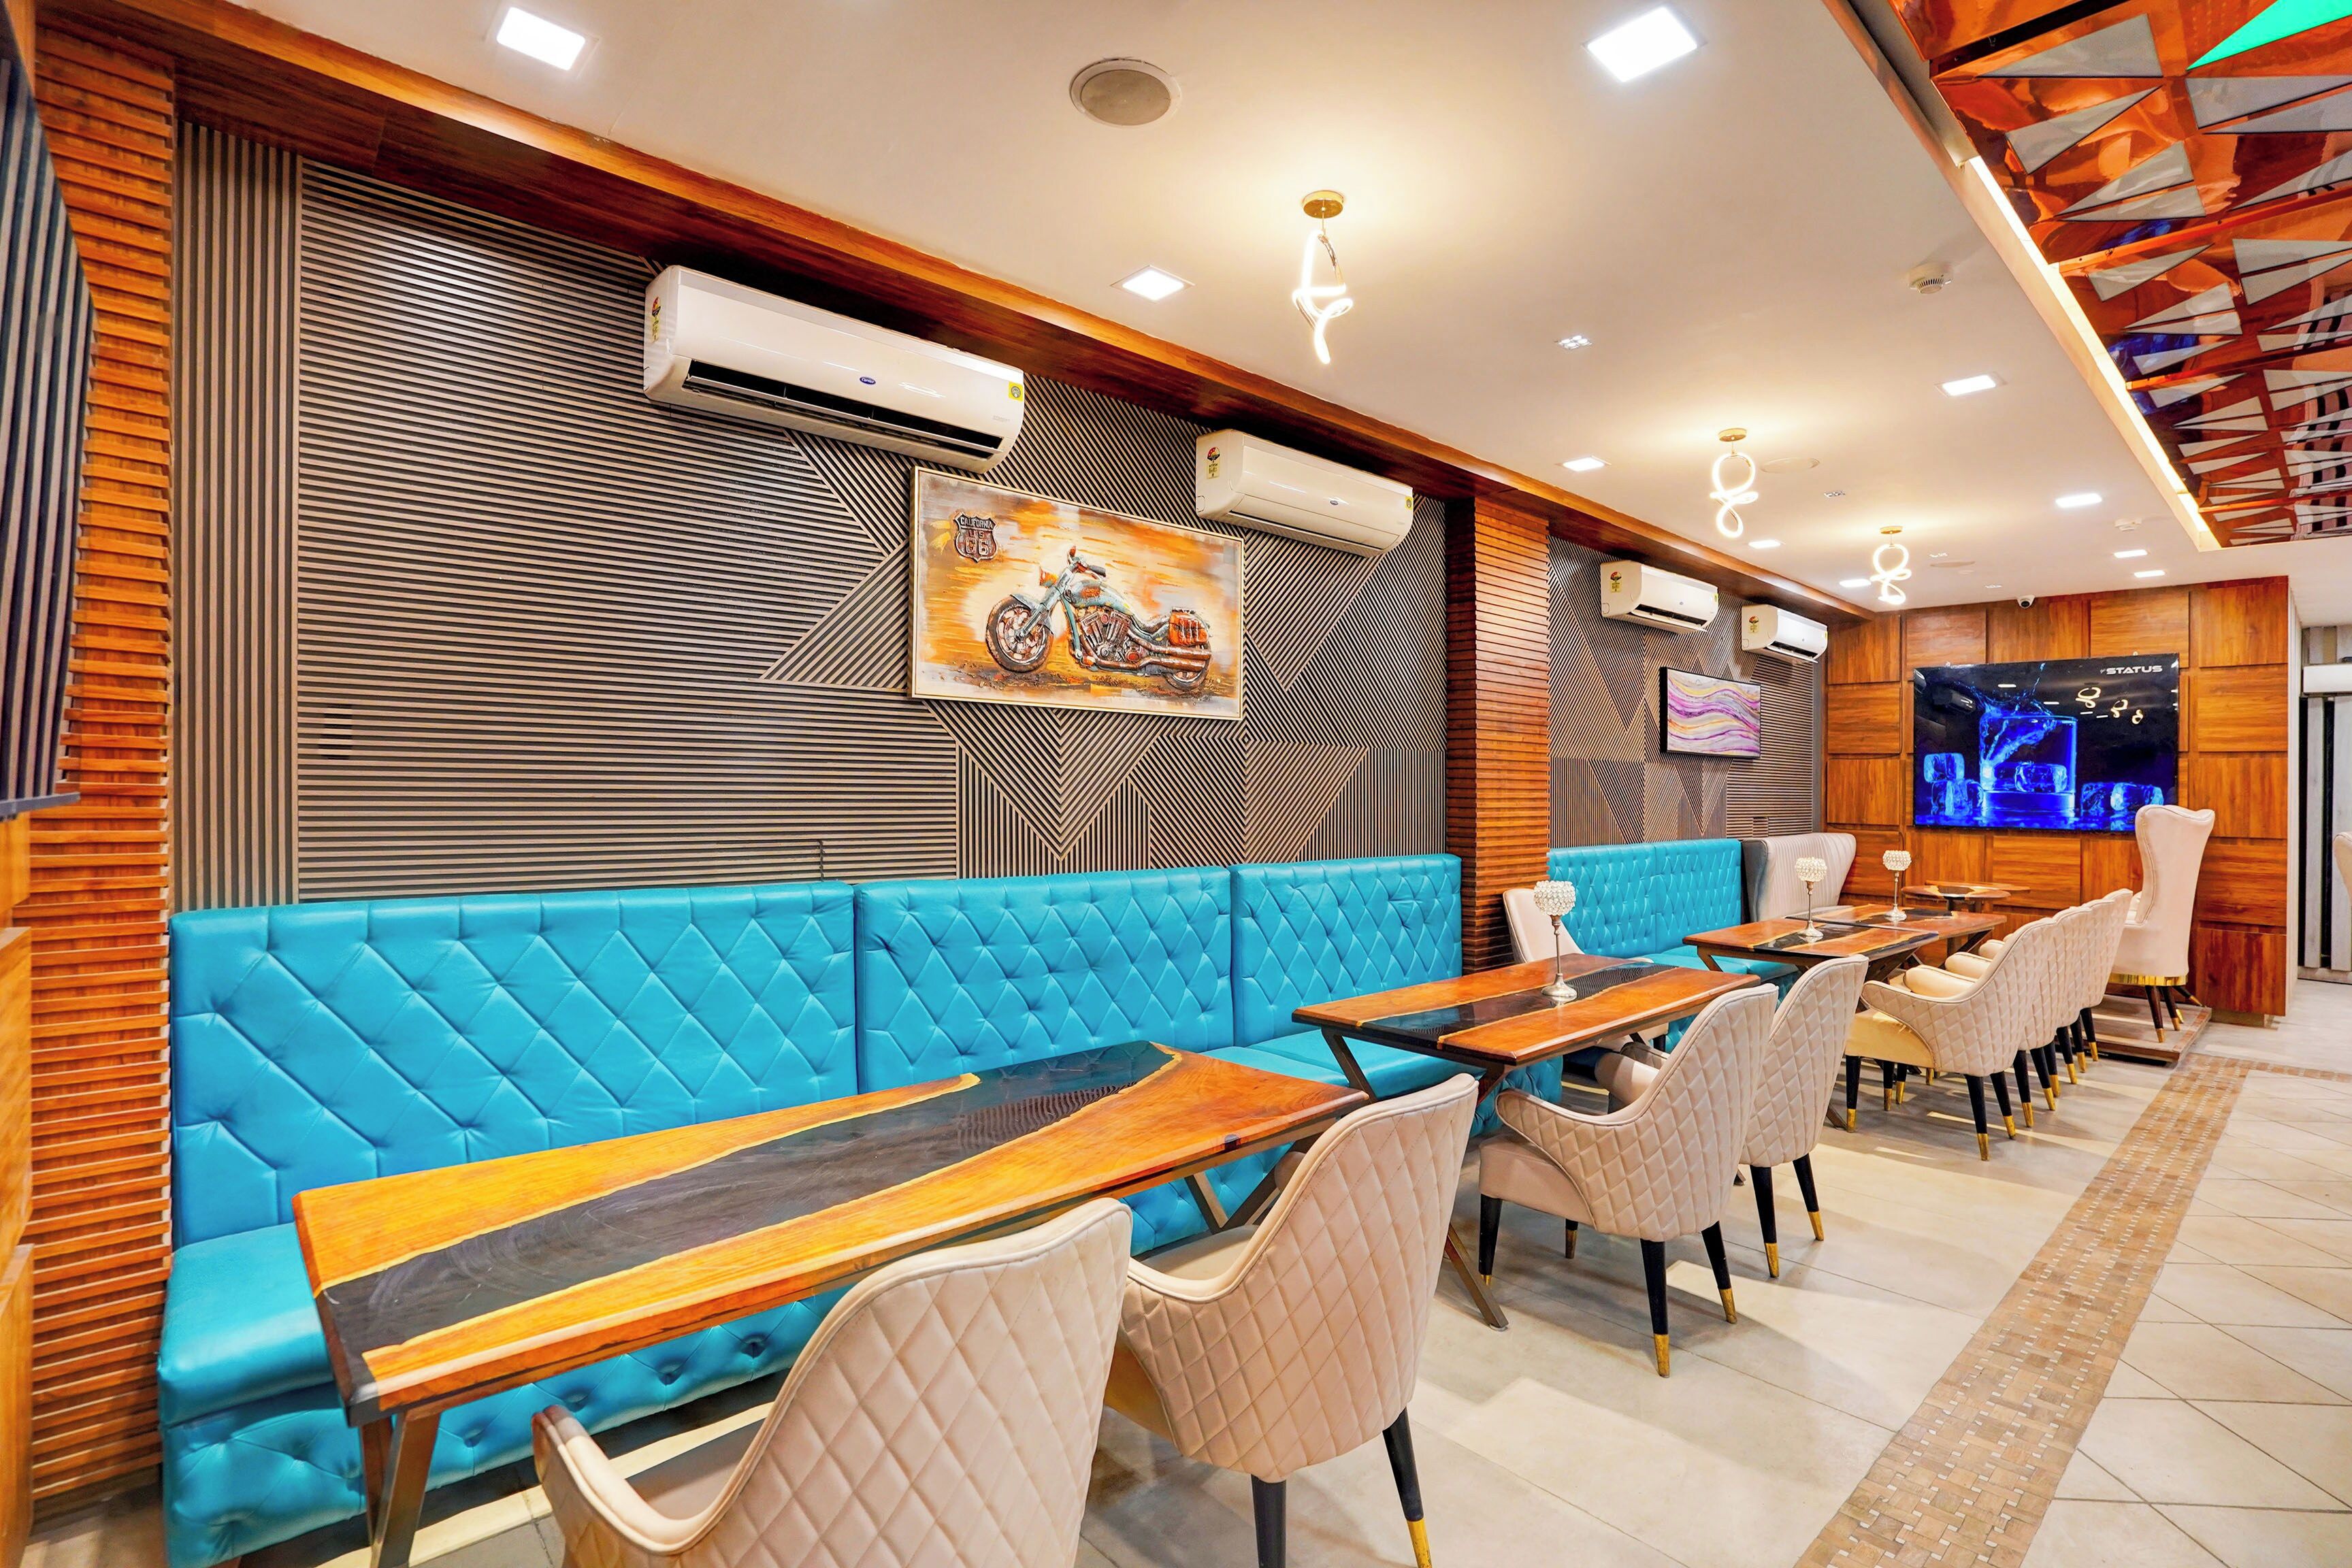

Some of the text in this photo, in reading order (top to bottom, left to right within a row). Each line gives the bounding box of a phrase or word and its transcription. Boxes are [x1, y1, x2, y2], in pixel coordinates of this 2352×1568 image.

[960, 517, 993, 529] CALIFORNIA
[965, 538, 989, 555] 66
[2106, 665, 2163, 675] STATUS
